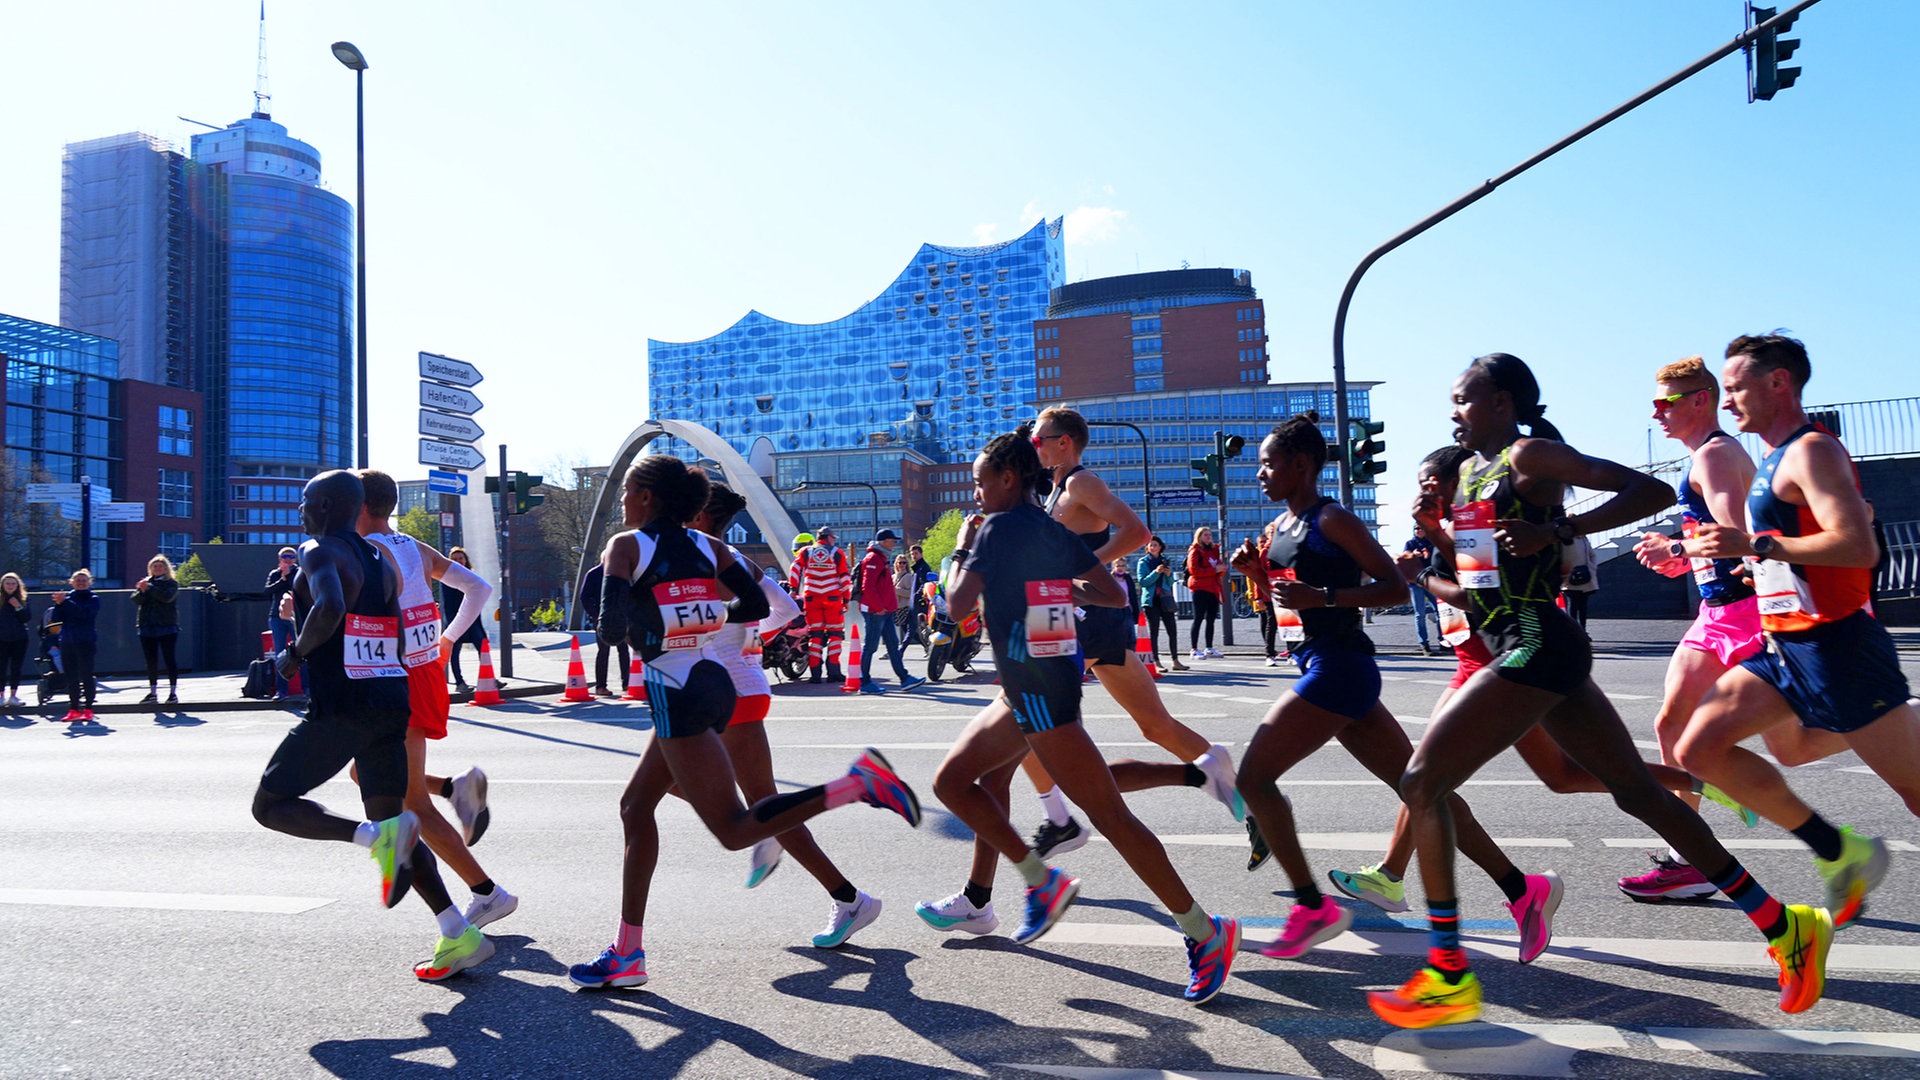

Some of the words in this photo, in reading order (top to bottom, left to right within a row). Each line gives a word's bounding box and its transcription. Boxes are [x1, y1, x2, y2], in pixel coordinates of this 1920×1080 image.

[427, 361, 470, 380] Speicherstadt
[427, 389, 468, 409] HafenCity
[426, 443, 447, 453] Cruise
[449, 446, 470, 456] Center
[440, 455, 470, 466] HafenCity
[682, 584, 707, 595] Haspa
[415, 608, 433, 619] Haspa
[674, 603, 717, 628] F14
[1048, 607, 1069, 631] F1
[361, 621, 384, 632] Haspa
[412, 624, 435, 646] 113
[669, 638, 696, 648] REWE
[353, 639, 386, 660] 114
